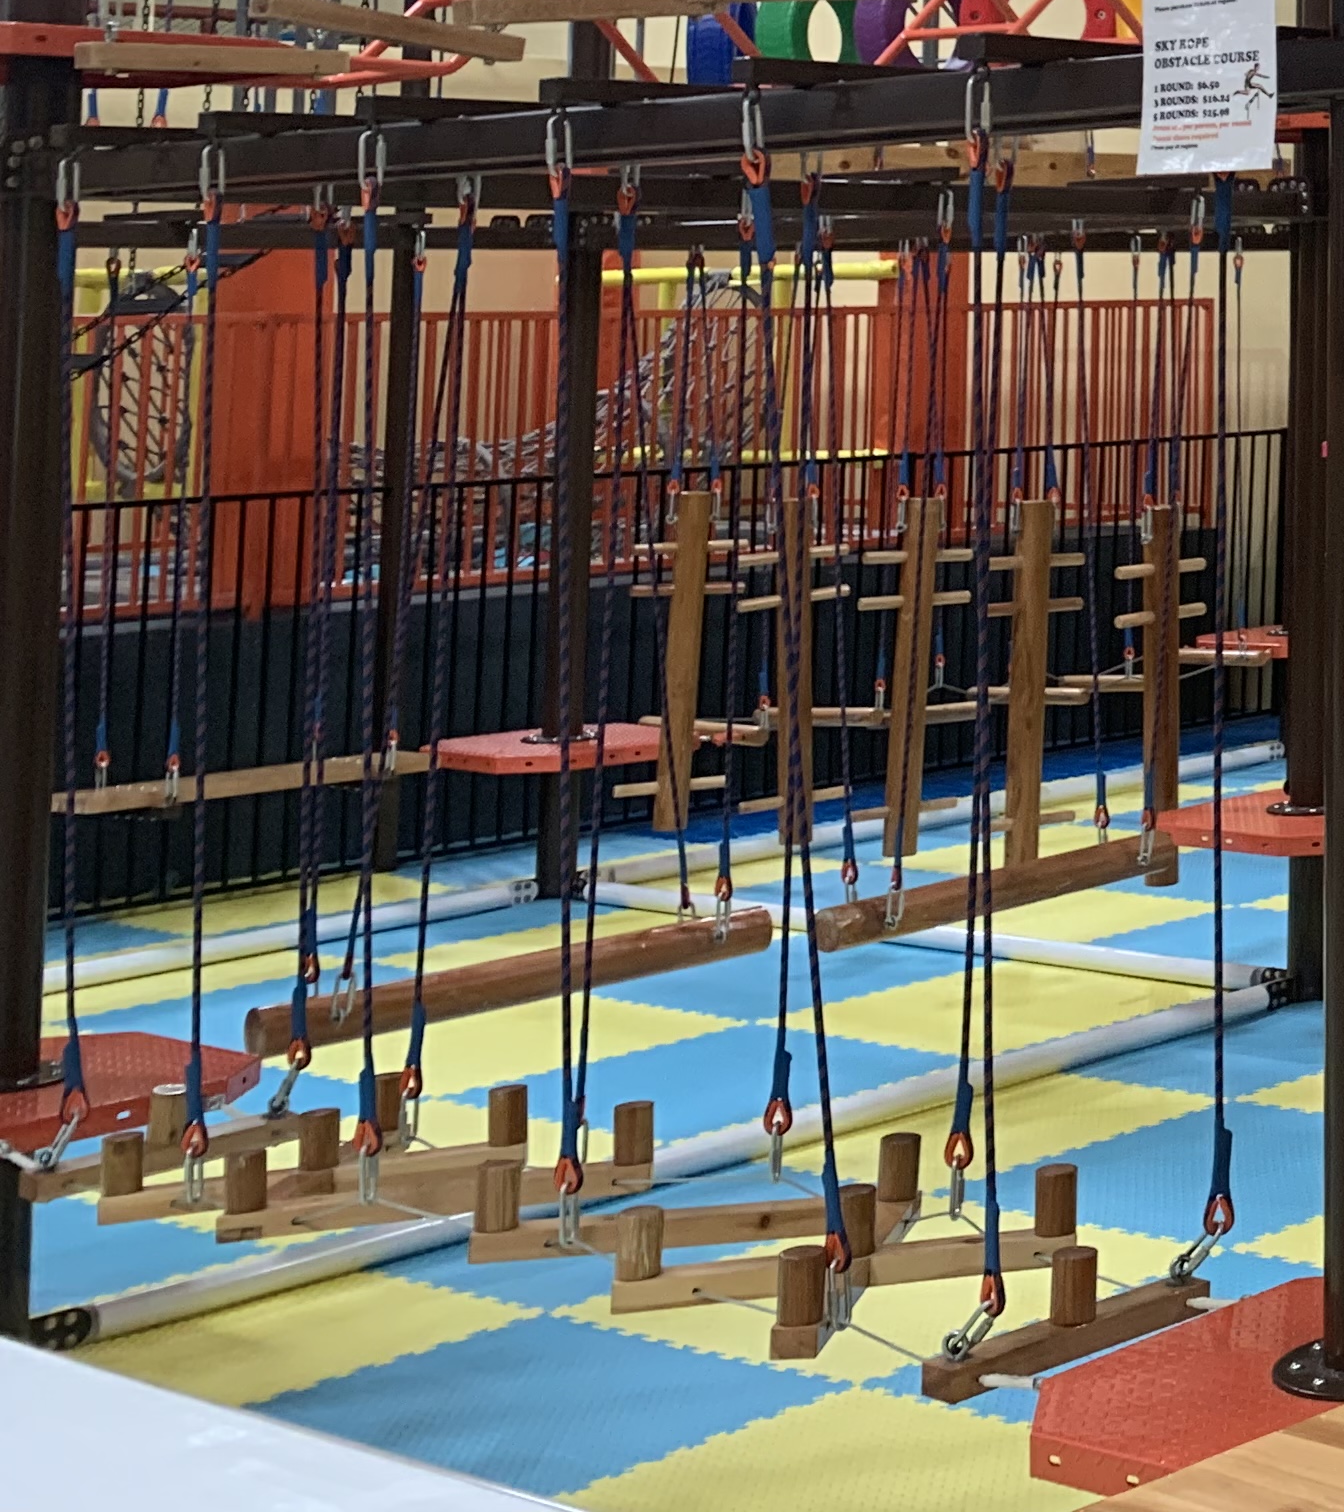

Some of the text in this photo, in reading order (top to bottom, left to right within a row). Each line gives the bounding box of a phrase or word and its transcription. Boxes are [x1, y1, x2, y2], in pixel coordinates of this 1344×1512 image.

[1155, 37, 1209, 52] SKY ROPE
[1154, 50, 1259, 69] OBSTACLE COURSE
[1160, 81, 1193, 93] ROUND:
[1160, 94, 1198, 106] ROUNDS:
[1160, 109, 1198, 121] ROUNDS:
